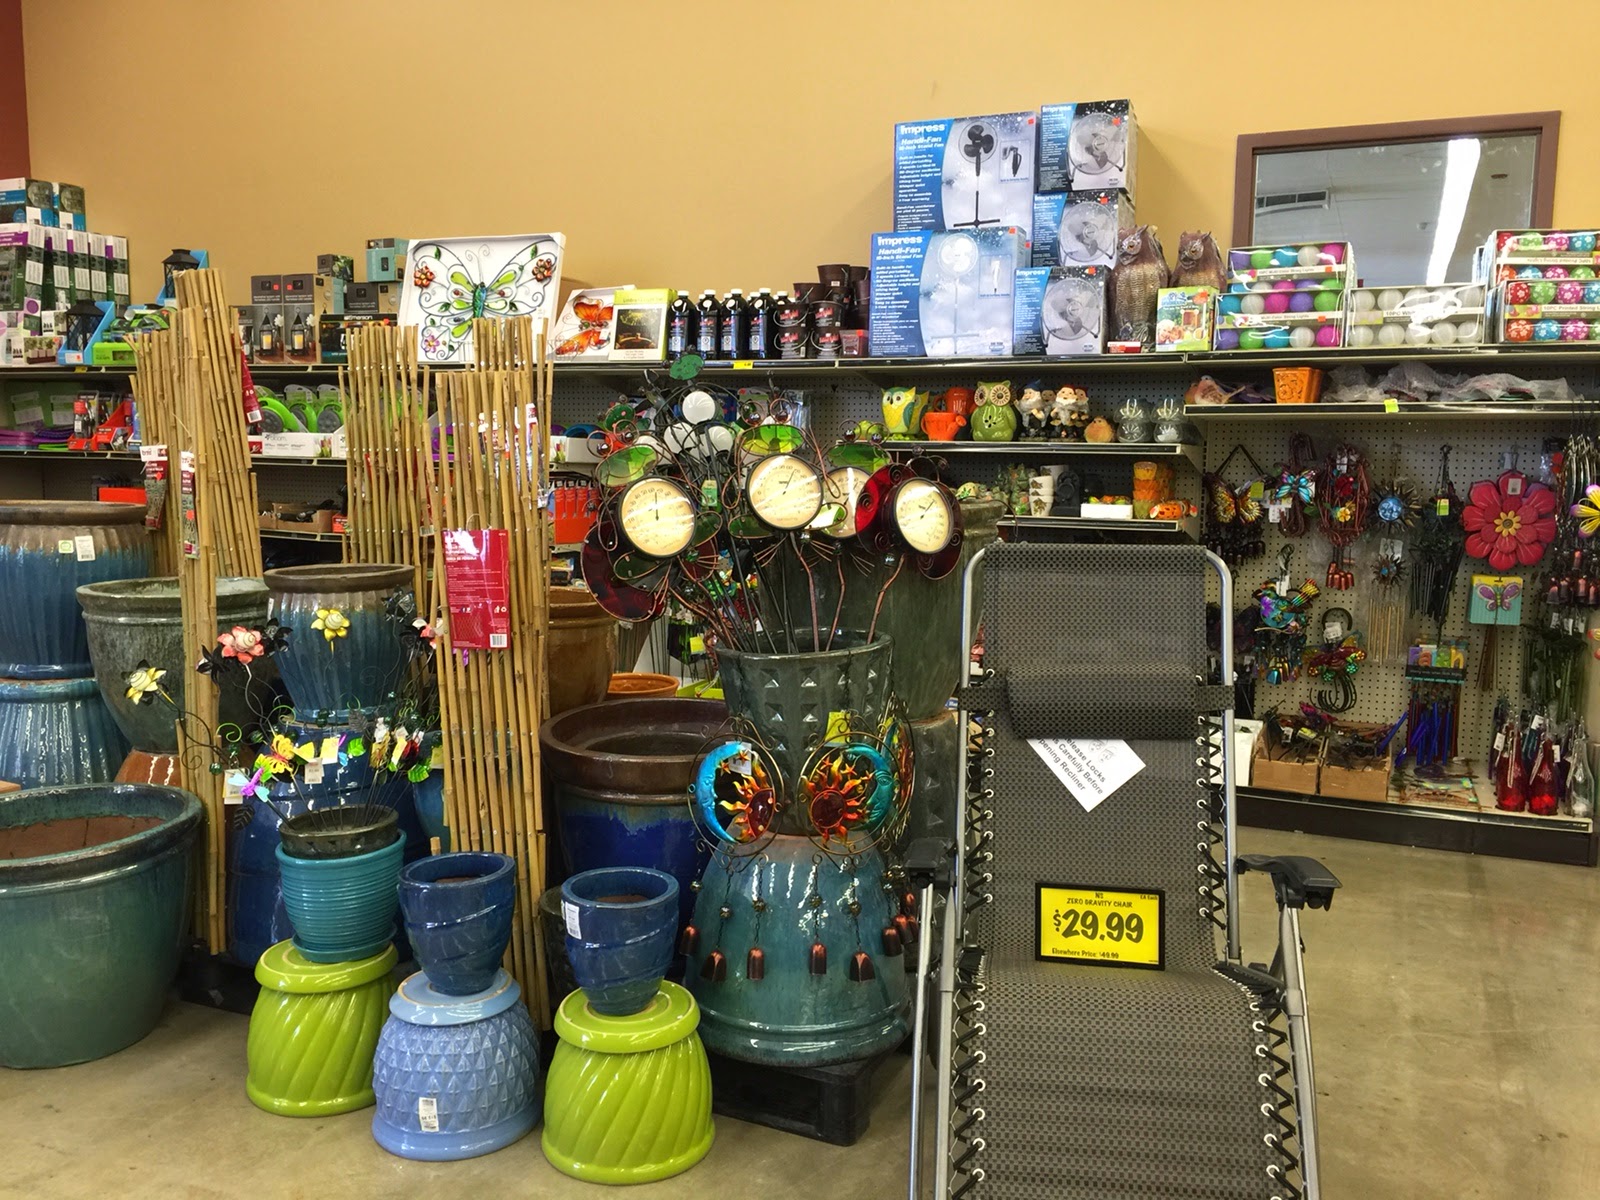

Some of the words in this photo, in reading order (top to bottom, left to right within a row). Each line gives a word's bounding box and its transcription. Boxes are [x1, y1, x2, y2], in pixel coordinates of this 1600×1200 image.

[1058, 743, 1084, 773] Carefully
[1083, 771, 1104, 794] Before
[1060, 761, 1086, 791] Recliner
[1065, 738, 1087, 761] elease
[1086, 760, 1106, 783] Locks
[1085, 899, 1112, 907] GRAVITY
[1053, 908, 1144, 944] $29.99
[1052, 948, 1080, 956] Elsewhere
